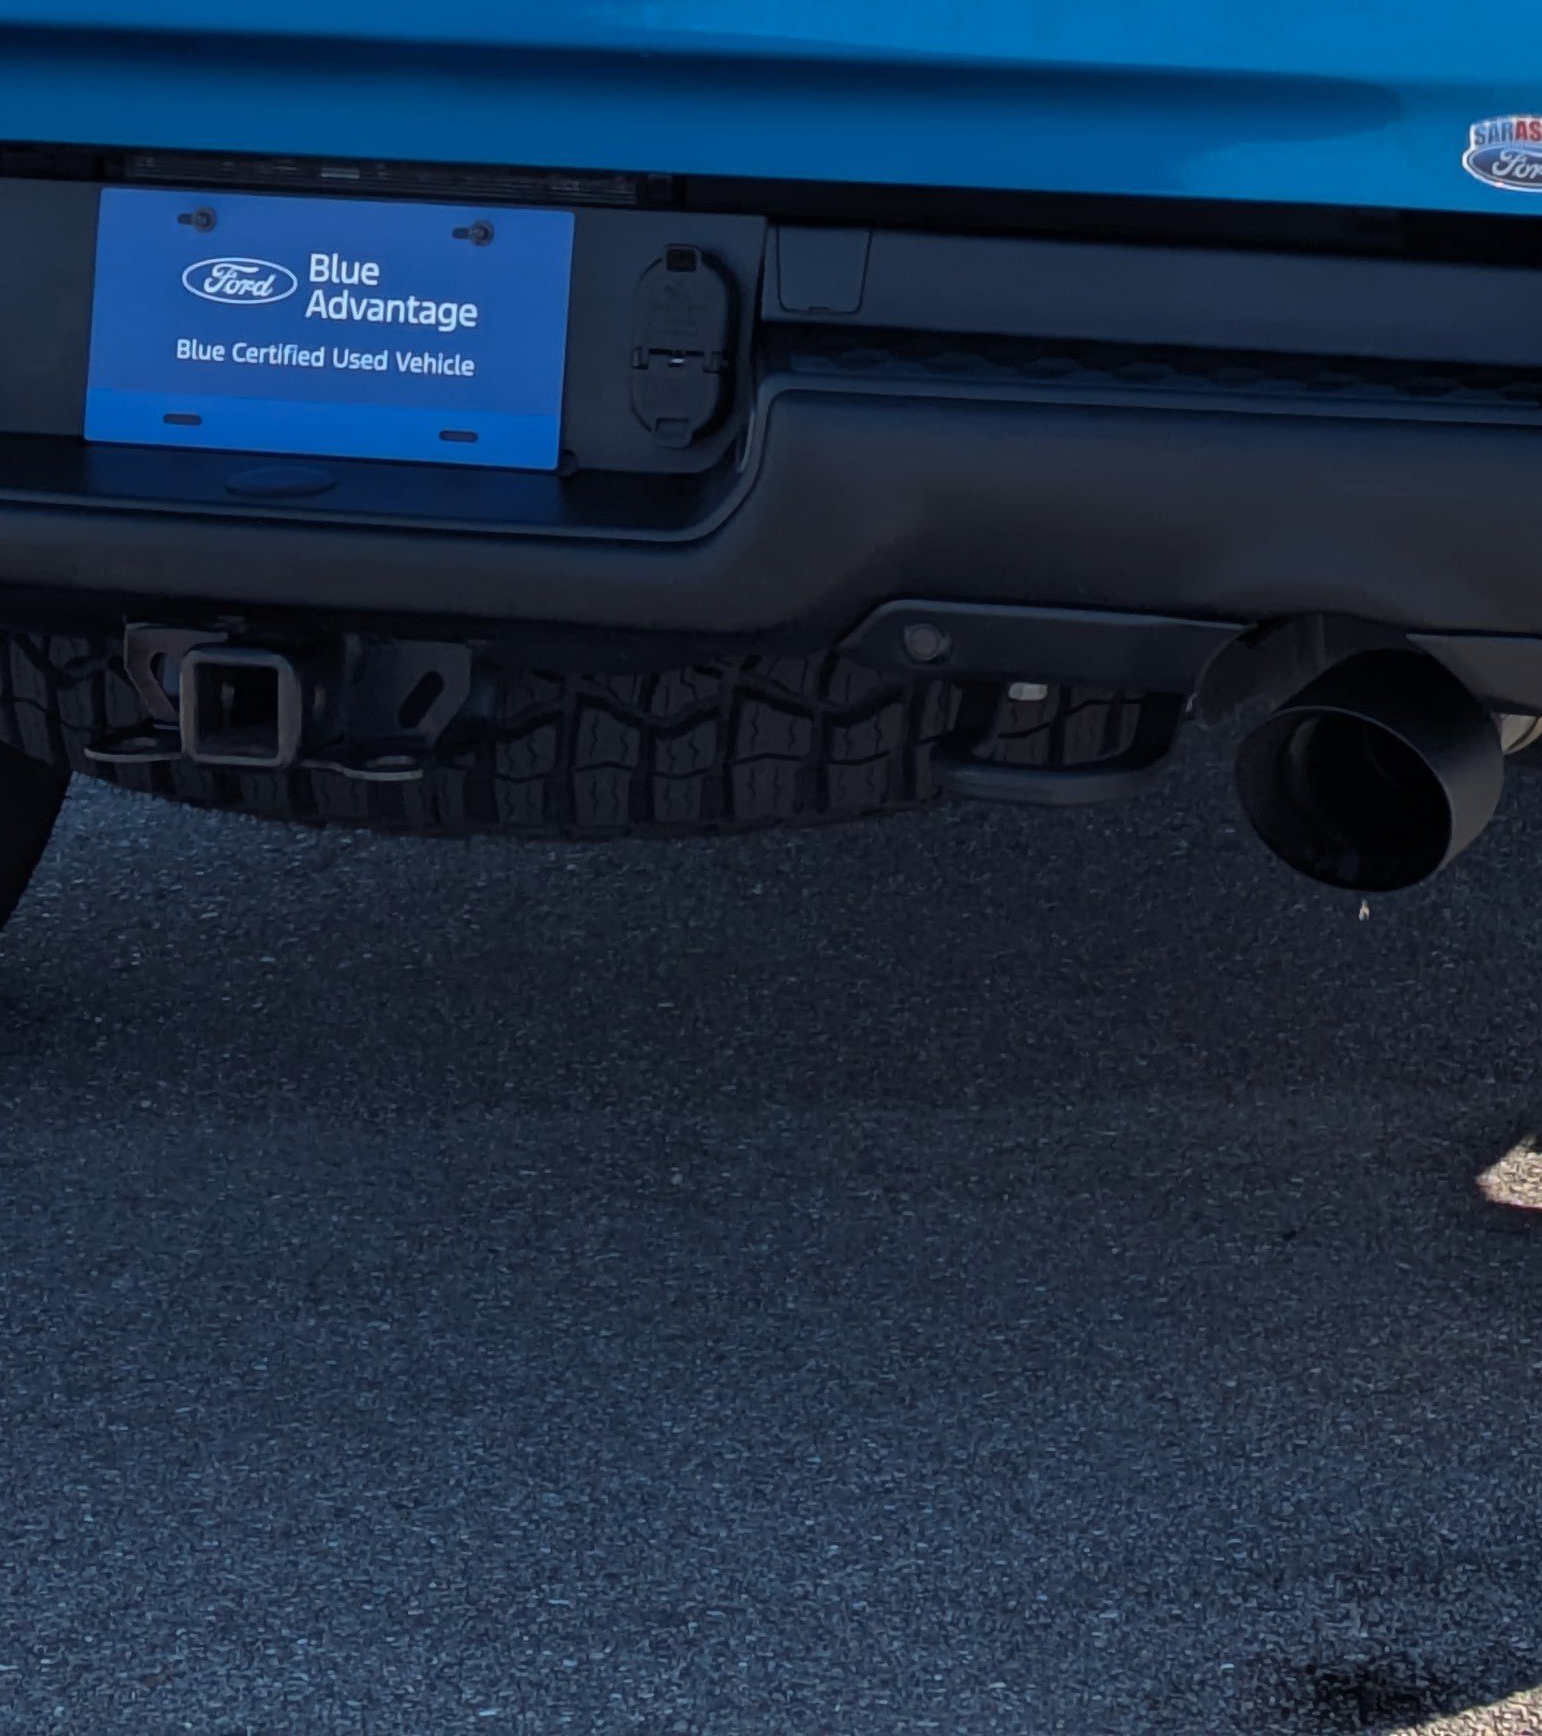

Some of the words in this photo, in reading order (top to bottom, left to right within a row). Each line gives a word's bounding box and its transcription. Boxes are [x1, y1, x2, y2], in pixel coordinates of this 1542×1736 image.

[203, 263, 278, 298] Ford
[309, 253, 380, 286] Blue
[304, 289, 478, 332] Advantage
[175, 338, 226, 362] Blue
[232, 342, 326, 368] Certified
[332, 347, 390, 373] Used
[395, 351, 476, 377] Vehicle
